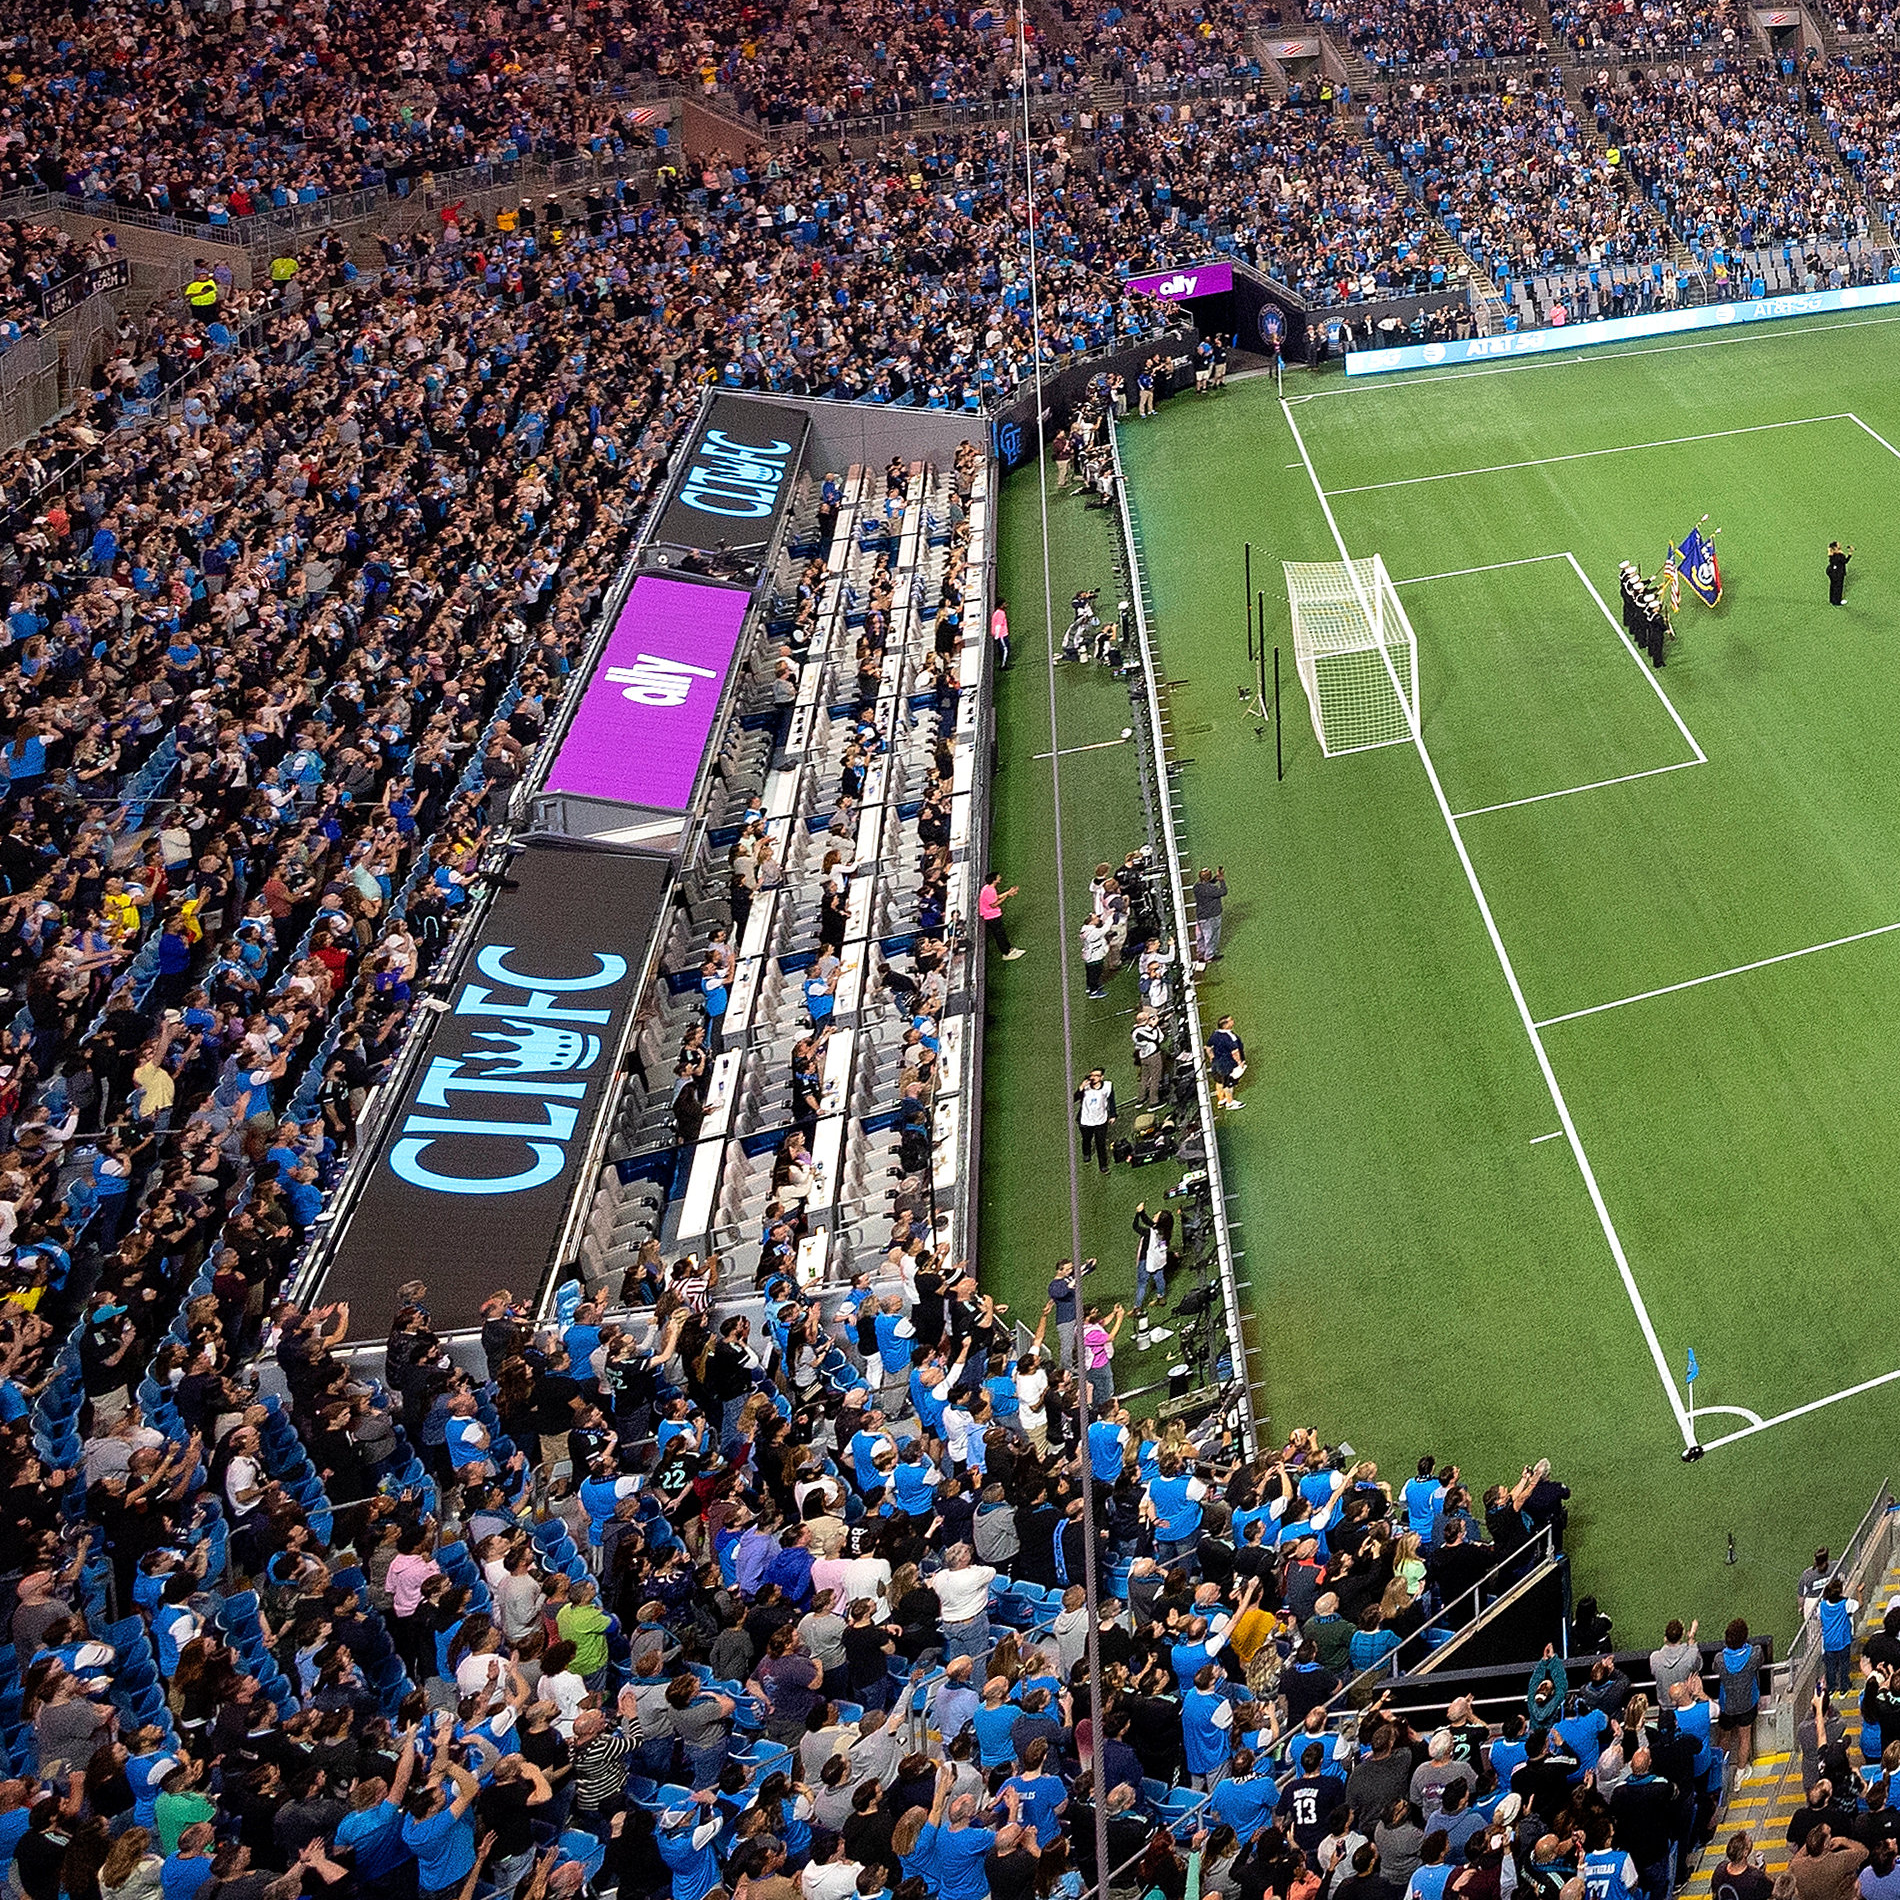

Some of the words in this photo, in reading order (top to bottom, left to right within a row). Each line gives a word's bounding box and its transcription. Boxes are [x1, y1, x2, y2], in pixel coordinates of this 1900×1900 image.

[1159, 274, 1198, 296] ally
[604, 653, 717, 707] ally
[455, 944, 628, 1025] FC
[389, 1055, 588, 1195] CLT
[660, 1469, 686, 1489] 22
